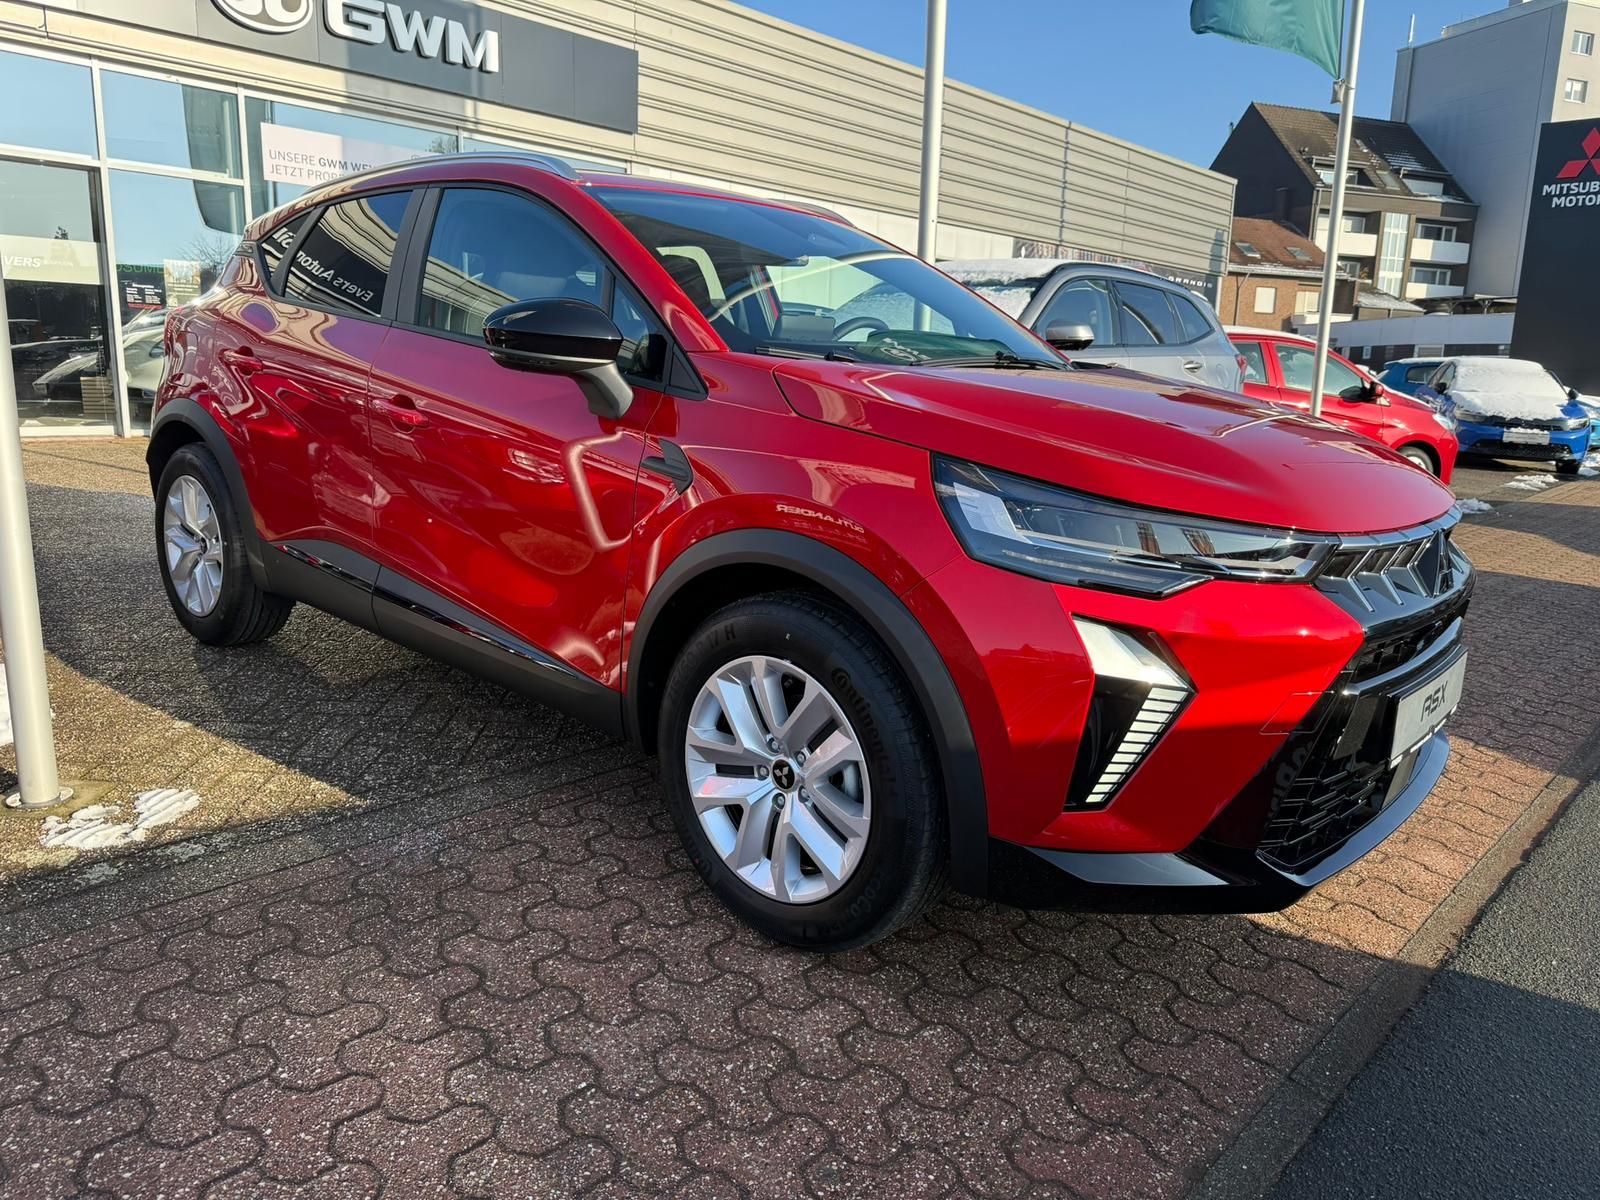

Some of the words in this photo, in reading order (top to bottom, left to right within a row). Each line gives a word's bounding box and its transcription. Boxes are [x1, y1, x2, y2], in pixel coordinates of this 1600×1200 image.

[323, 0, 499, 73] GWM
[269, 149, 316, 166] UNSERE
[318, 157, 348, 171] GWM
[350, 162, 376, 172] WE
[270, 163, 304, 178] JETZT
[307, 168, 345, 182] PRO
[1542, 181, 1600, 196] MITSUB
[3, 255, 42, 268] VERS
[1420, 680, 1448, 722] ASX
